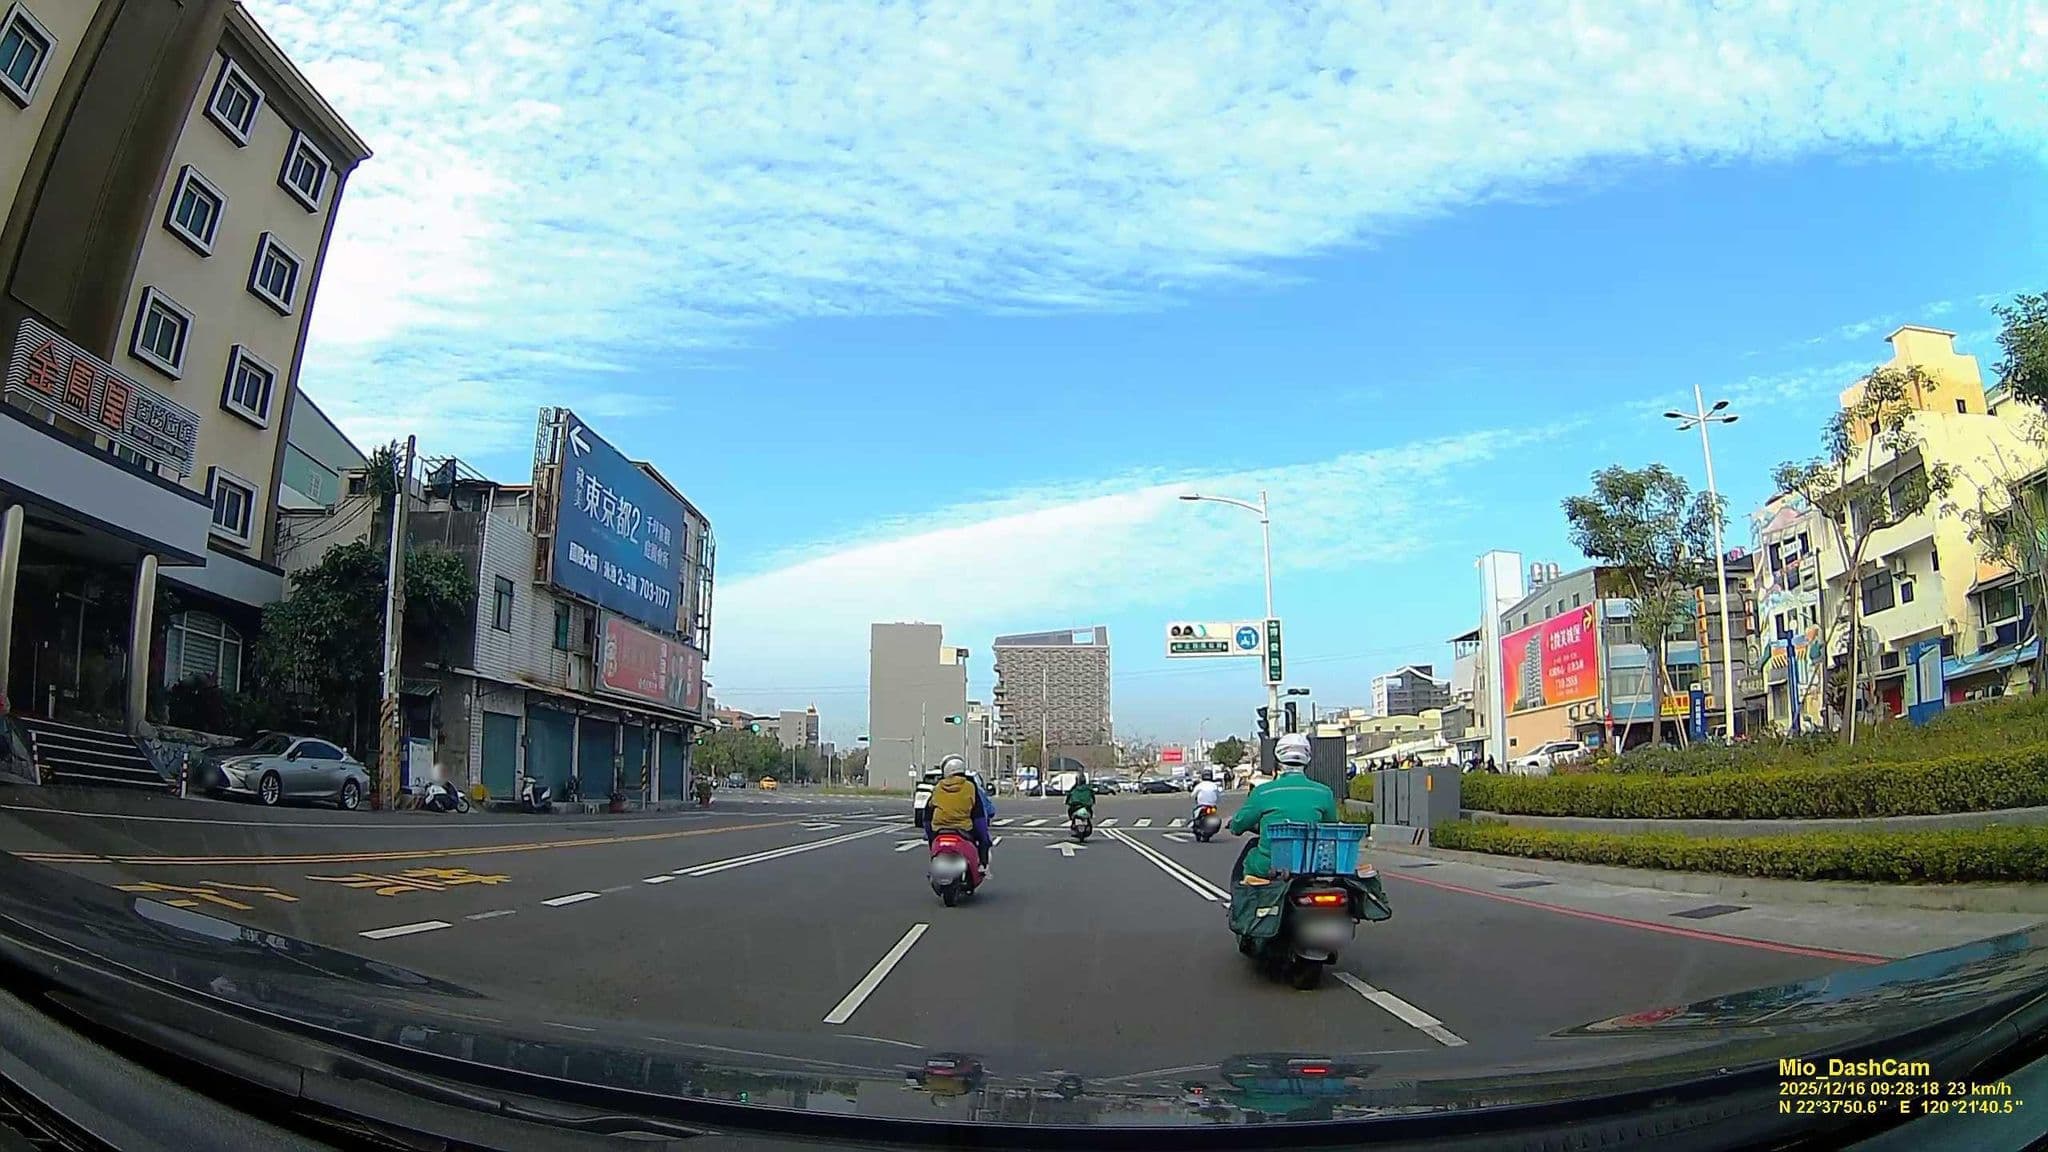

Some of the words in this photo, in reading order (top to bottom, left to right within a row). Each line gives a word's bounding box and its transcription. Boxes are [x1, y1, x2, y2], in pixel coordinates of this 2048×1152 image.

[25, 339, 133, 432] 金鳳凰
[582, 473, 641, 545] 東京都2
[638, 575, 671, 610] 703-1177
